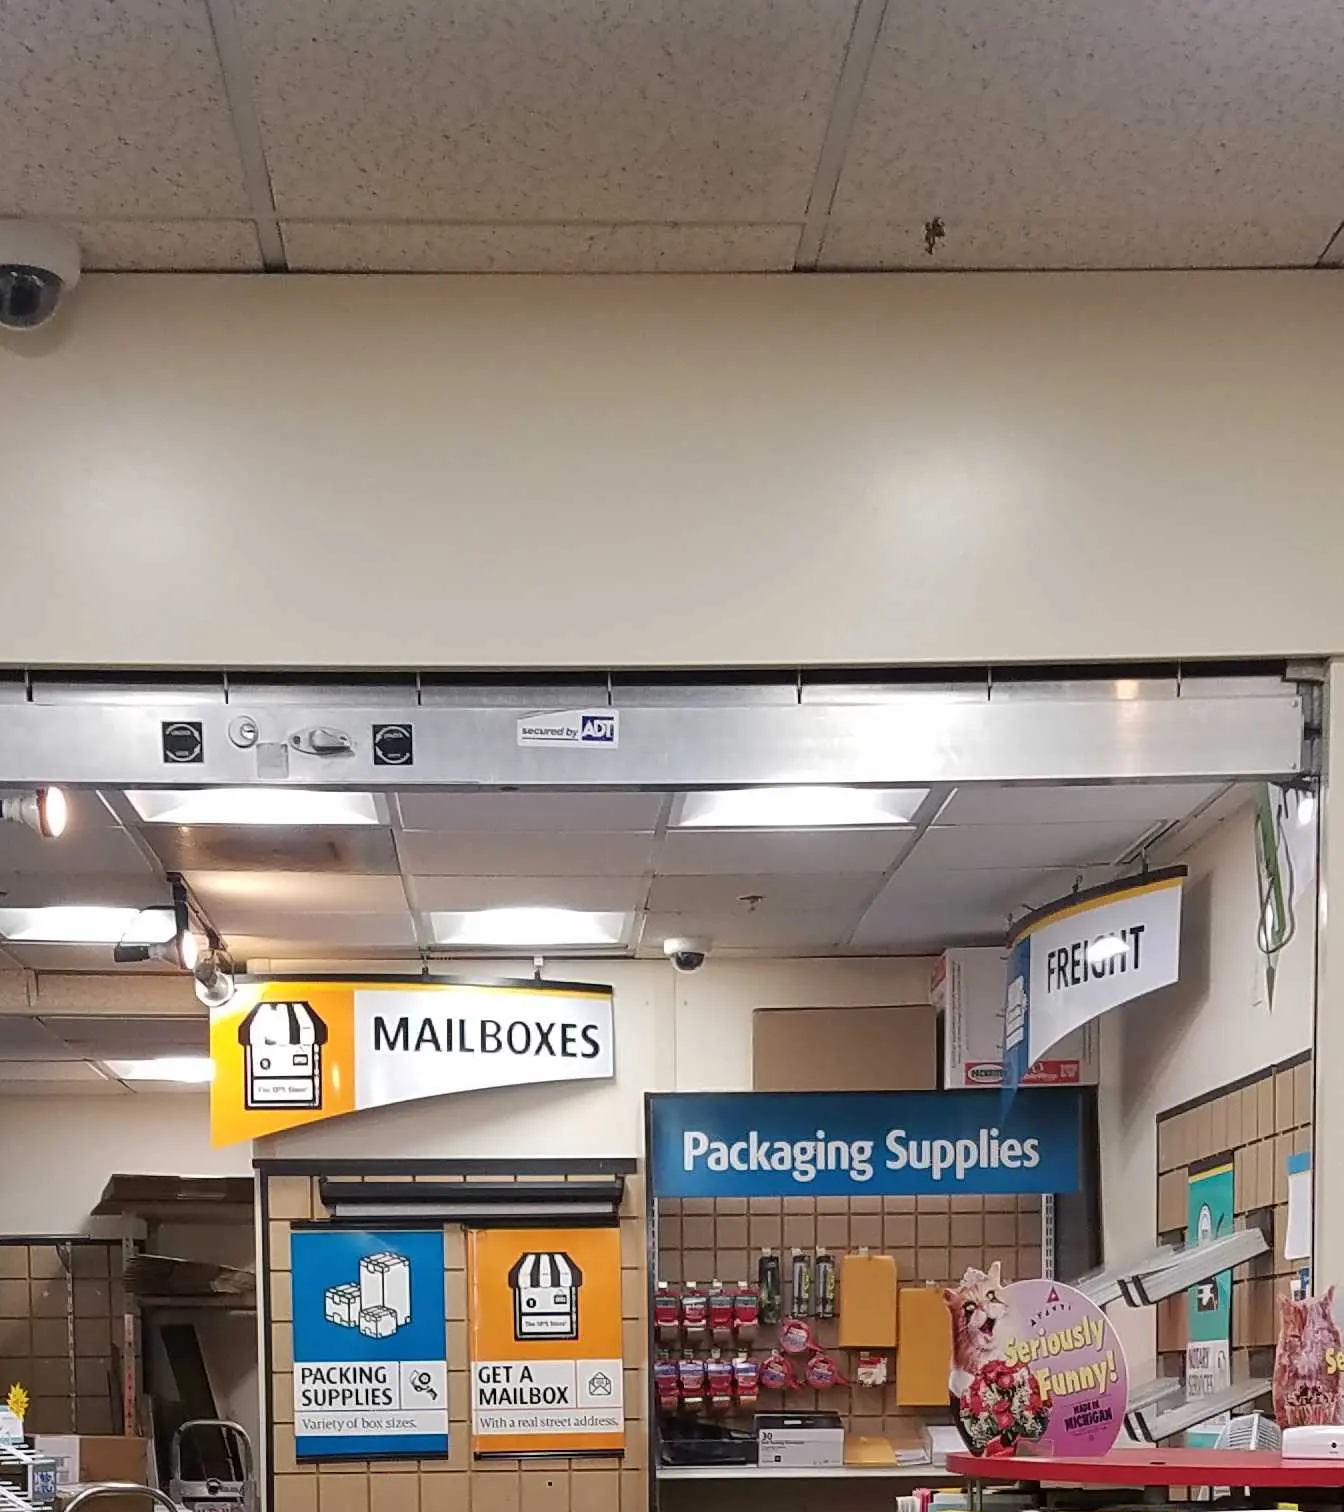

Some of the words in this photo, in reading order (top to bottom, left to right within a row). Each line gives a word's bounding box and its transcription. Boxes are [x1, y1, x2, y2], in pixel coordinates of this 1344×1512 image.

[522, 727, 564, 737] secured
[566, 727, 579, 739] by
[582, 718, 615, 739] ADT
[373, 1015, 601, 1059] MAILBOXES
[682, 1129, 874, 1182] Packaging
[885, 1127, 1040, 1180] Supplies
[1005, 1315, 1105, 1367] Seriously
[301, 1366, 387, 1385] PACKING
[478, 1366, 514, 1385] GET
[519, 1366, 534, 1384] A
[1036, 1350, 1118, 1401] Funny!
[301, 1388, 393, 1407] SUPPLIES
[479, 1386, 570, 1406] MAILBOX
[302, 1416, 345, 1432] Variety
[346, 1416, 358, 1430] of
[361, 1416, 383, 1429] box
[385, 1416, 417, 1429] sizes.
[480, 1416, 503, 1429] With
[505, 1419, 515, 1429] a
[517, 1416, 537, 1429] real
[538, 1416, 572, 1429] street
[573, 1415, 619, 1428] address.
[1064, 1408, 1113, 1431] MICHIGAN
